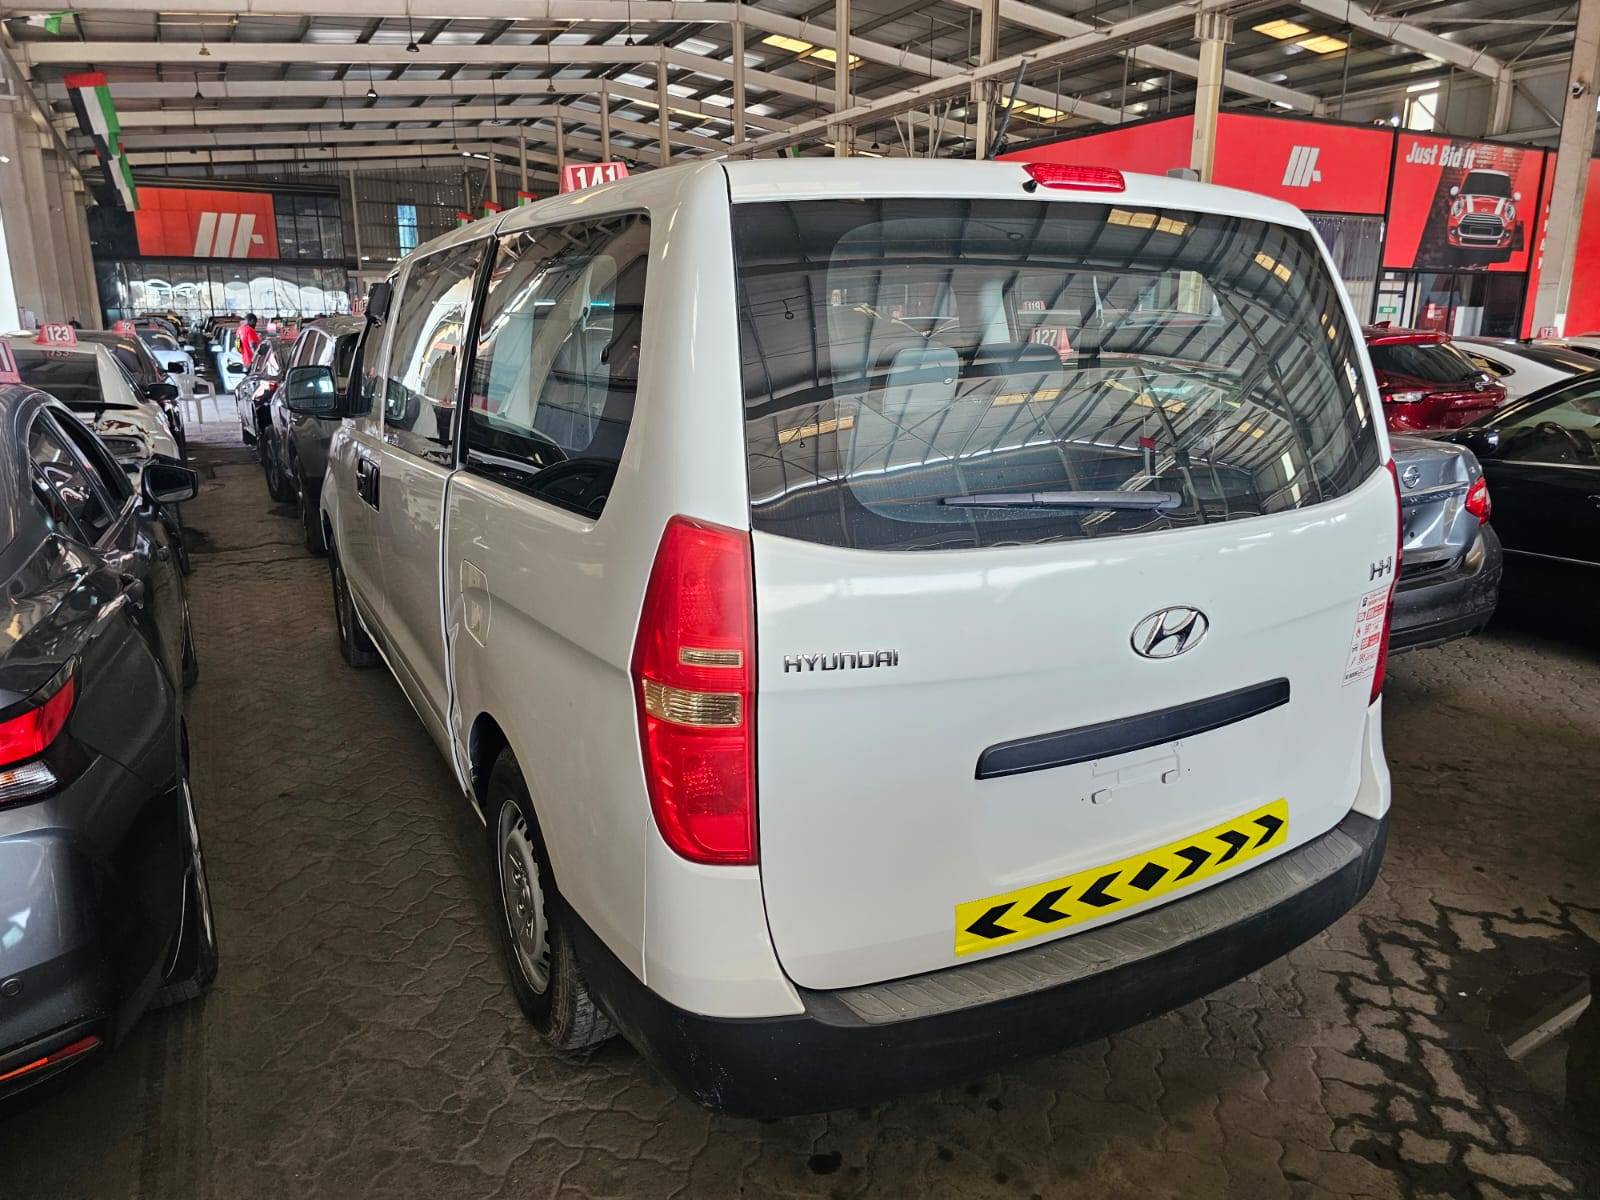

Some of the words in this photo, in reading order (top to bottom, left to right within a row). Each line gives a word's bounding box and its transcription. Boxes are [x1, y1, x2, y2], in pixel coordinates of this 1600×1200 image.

[1405, 141, 1439, 165] Just
[1438, 145, 1464, 168] Bid
[1463, 147, 1476, 169] It
[577, 166, 616, 189] 141
[47, 326, 70, 341] 123
[1035, 329, 1058, 346] 127
[783, 649, 899, 673] HYUNDAI
